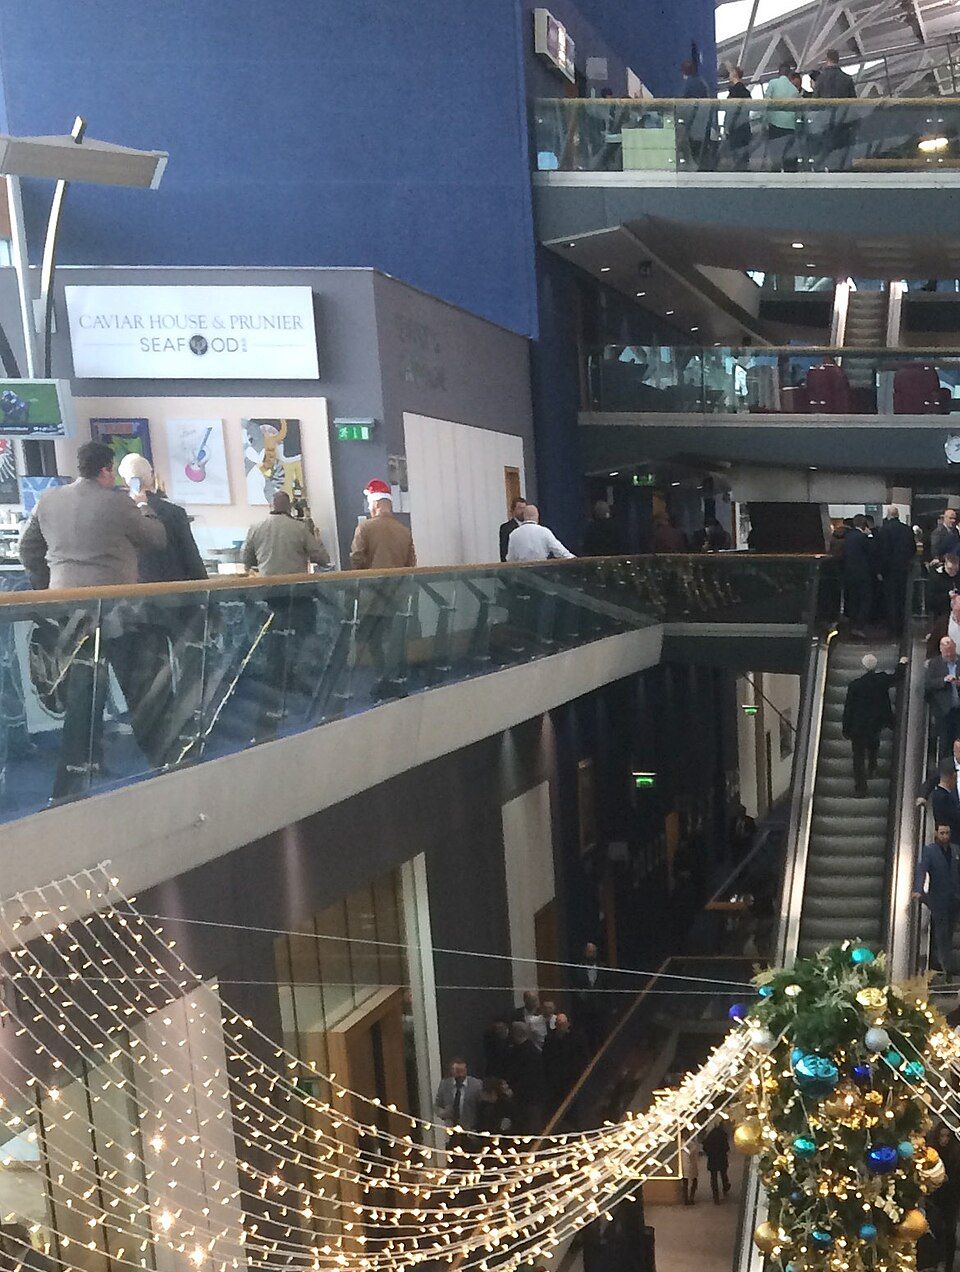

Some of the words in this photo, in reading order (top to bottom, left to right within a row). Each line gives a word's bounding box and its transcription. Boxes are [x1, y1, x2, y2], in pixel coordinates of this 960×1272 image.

[79, 314, 144, 330] CAVIAR
[149, 314, 208, 330] HOUSE
[211, 314, 226, 330] &
[229, 314, 304, 330] PRUNIER
